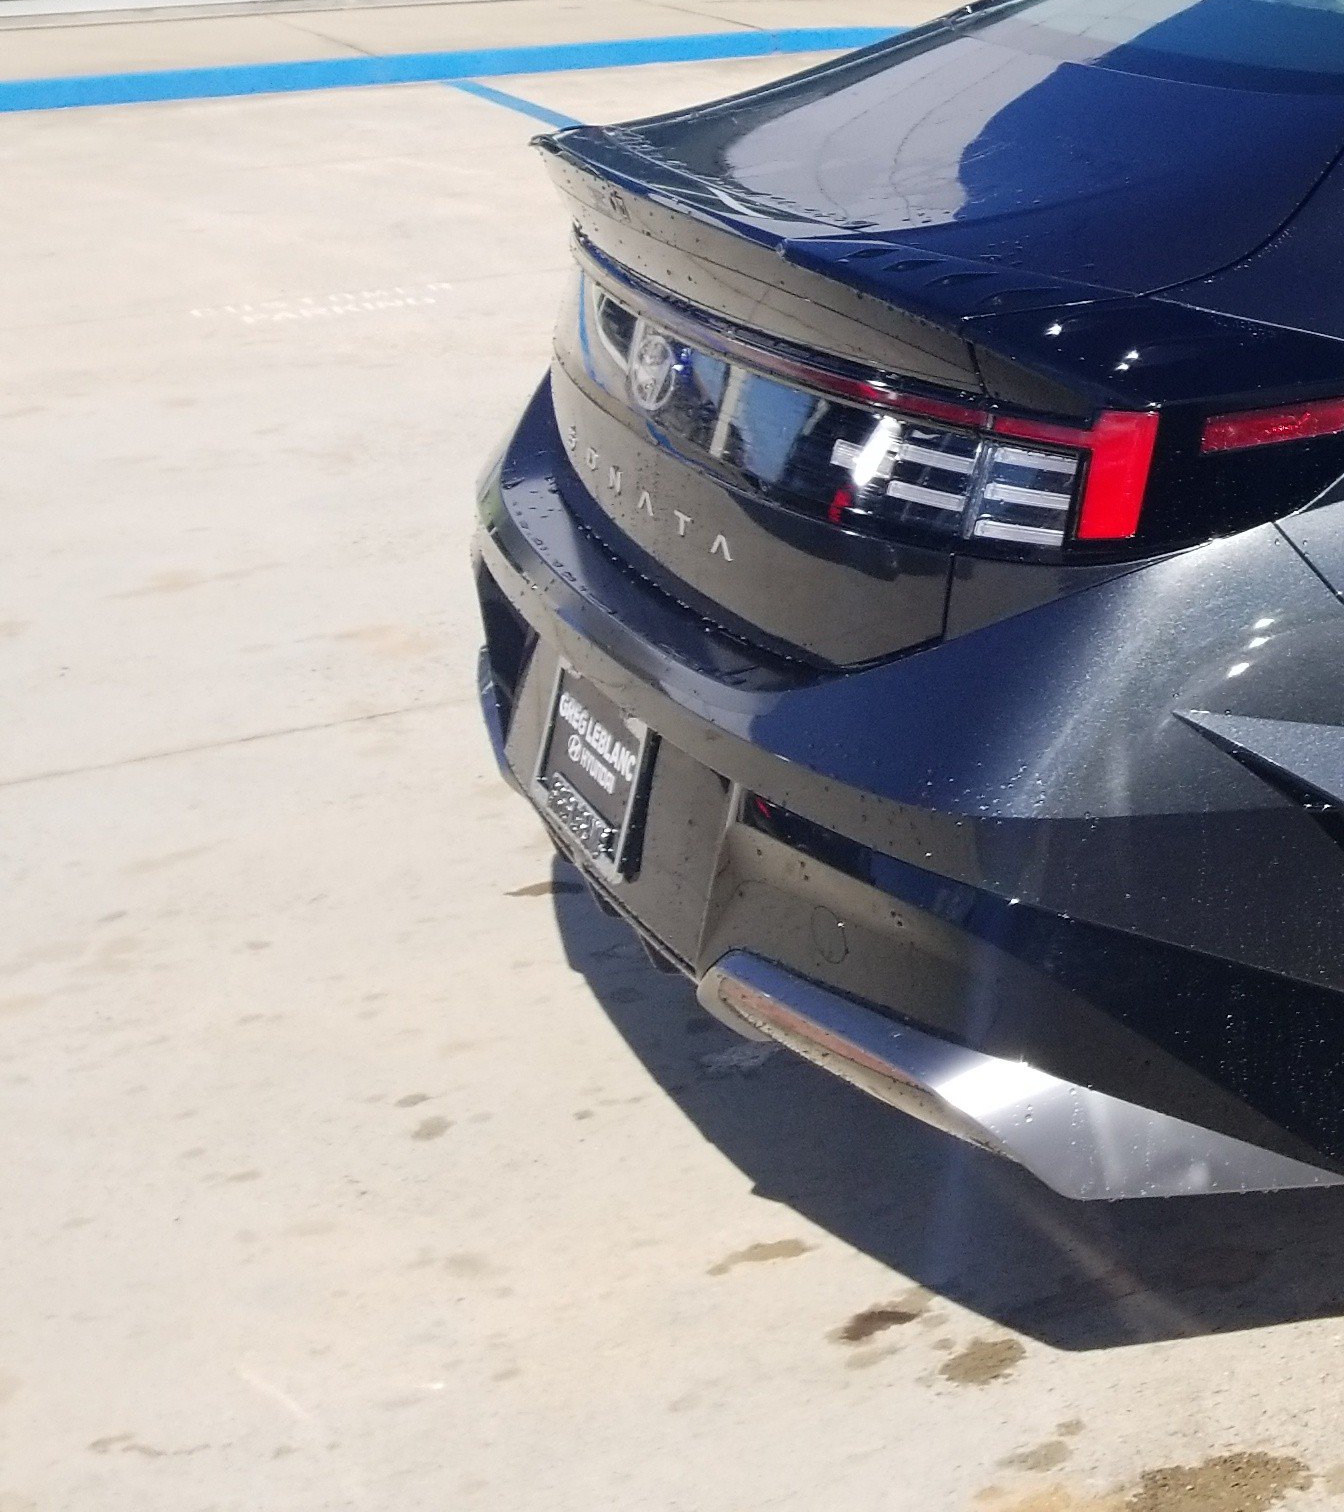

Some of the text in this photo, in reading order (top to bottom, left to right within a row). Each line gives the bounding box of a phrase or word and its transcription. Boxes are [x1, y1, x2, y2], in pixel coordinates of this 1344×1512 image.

[568, 424, 734, 562] SONATA
[558, 691, 636, 782] GREG LEBLANC
